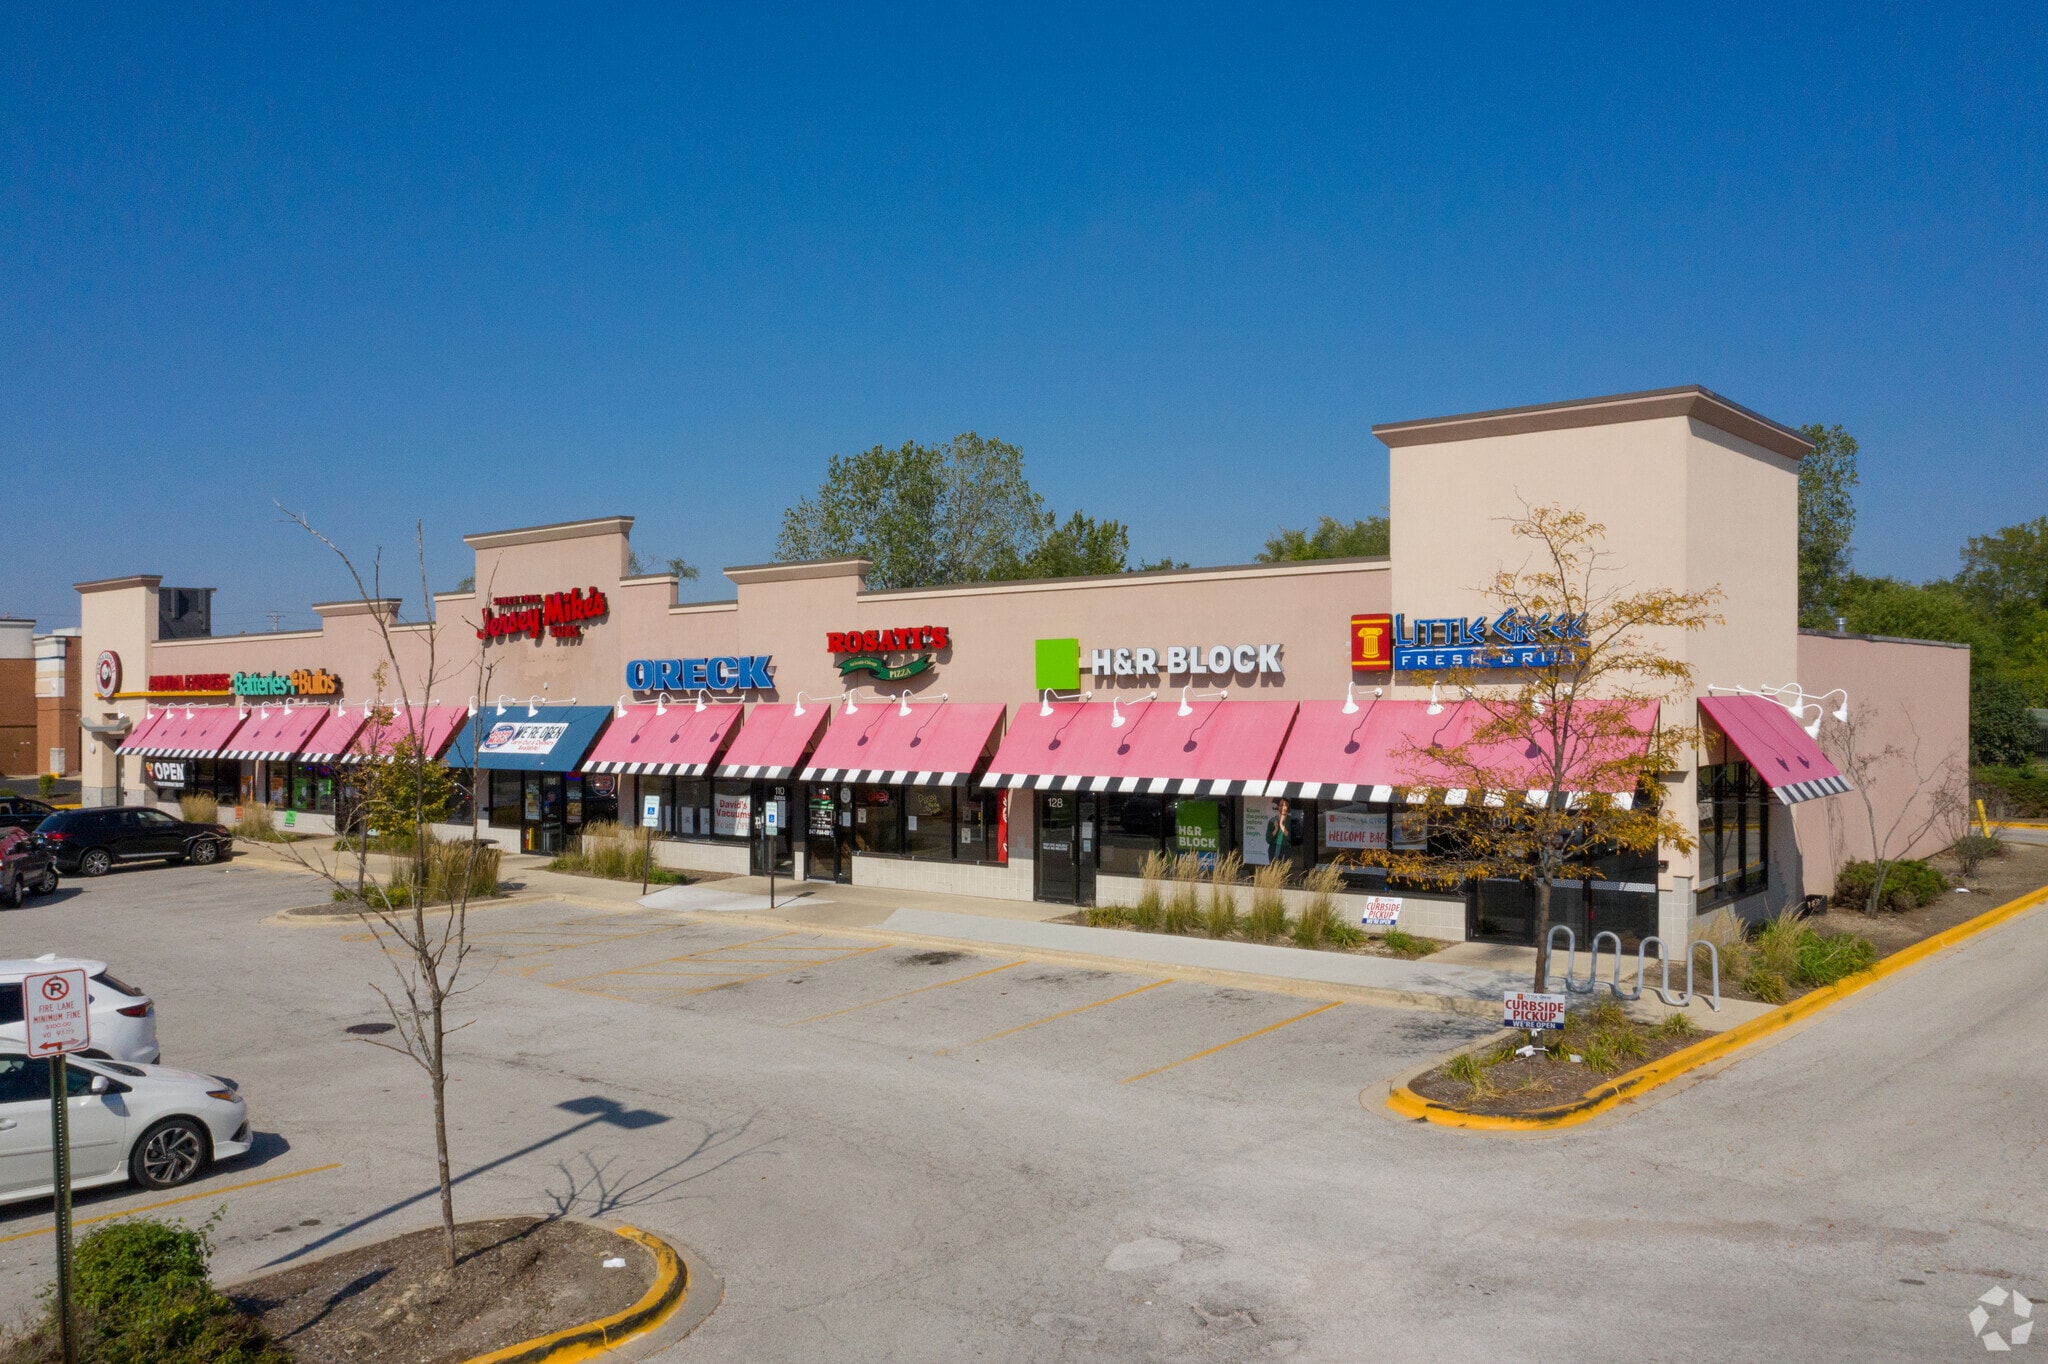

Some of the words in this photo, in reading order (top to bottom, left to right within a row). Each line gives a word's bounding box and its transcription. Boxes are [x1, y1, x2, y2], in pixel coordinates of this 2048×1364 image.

[477, 608, 539, 639] Jersey
[544, 586, 604, 626] Mike's
[551, 625, 578, 637] SUBS
[826, 626, 947, 653] ROSATI'S
[1092, 647, 1158, 675] H&R
[1167, 644, 1282, 673] BLOCK
[1402, 653, 1483, 666] FRESH
[626, 655, 773, 691] ORECK
[889, 668, 911, 678] PIZZA
[540, 726, 566, 739] OPEN
[155, 762, 184, 780] OPEN
[720, 799, 748, 809] David's
[1047, 798, 1063, 808] 128
[716, 808, 752, 819] Vacuums
[1178, 826, 1202, 836] H&R
[1328, 829, 1366, 843] WELCOME
[1178, 838, 1216, 848] BLOCK
[1366, 902, 1401, 912] CURBSIDE
[1368, 910, 1394, 920] PICKUP
[38, 1004, 54, 1013] FIRE
[57, 1000, 75, 1011] LANE
[1505, 999, 1564, 1013] CURBSIDE
[33, 1013, 64, 1024] MINIMUM
[66, 1009, 82, 1019] FINE
[1513, 1009, 1557, 1021] PICKUP
[1512, 1020, 1535, 1028] WE'RE
[1535, 1021, 1556, 1029] OPEN
